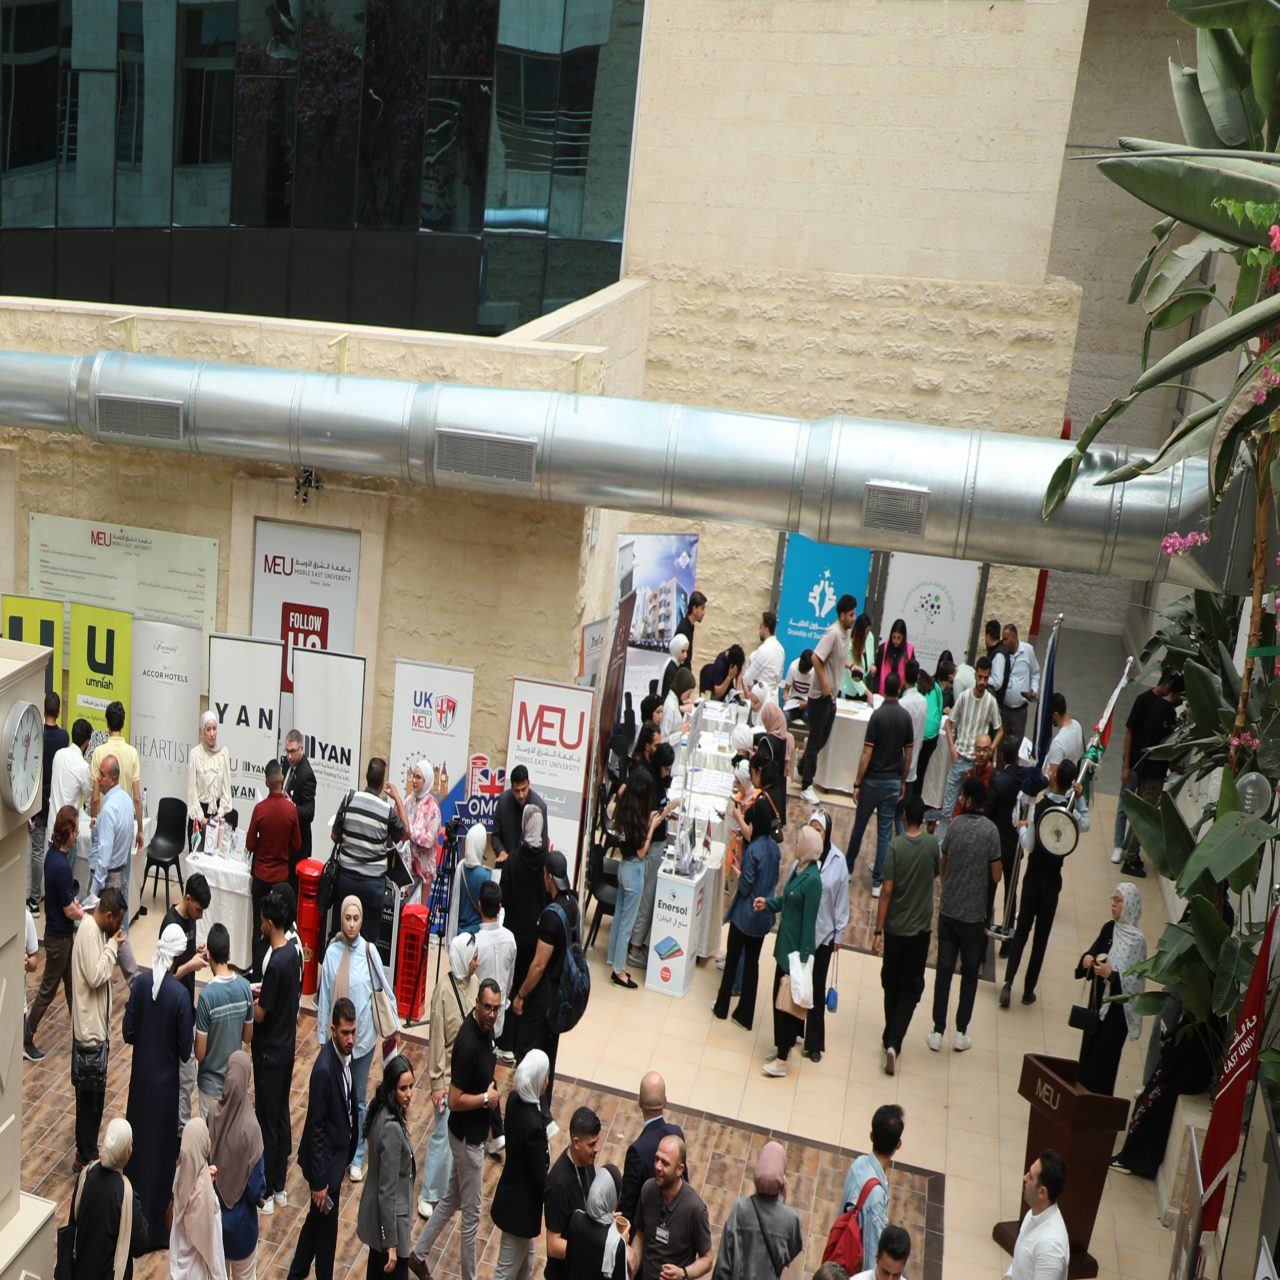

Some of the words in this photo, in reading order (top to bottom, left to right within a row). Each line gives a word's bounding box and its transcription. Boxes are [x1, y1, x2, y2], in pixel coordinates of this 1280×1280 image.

[91, 530, 112, 547] MEU
[264, 554, 293, 576] MEU
[312, 570, 322, 579] EAST
[289, 612, 322, 632] FOLLOW
[143, 669, 163, 679] ACCOR
[165, 673, 188, 683] HOTELS
[413, 690, 433, 709] UK
[412, 715, 432, 729] MEU
[517, 701, 585, 750] MEU
[134, 734, 191, 764] HEARTIST
[515, 755, 533, 766] MIDDLE
[535, 758, 548, 767] EAST
[549, 760, 580, 772] UNIVERSITY
[658, 899, 687, 916] Enersol
[1223, 1050, 1239, 1075] EAST
[1036, 1078, 1060, 1110] MEU
